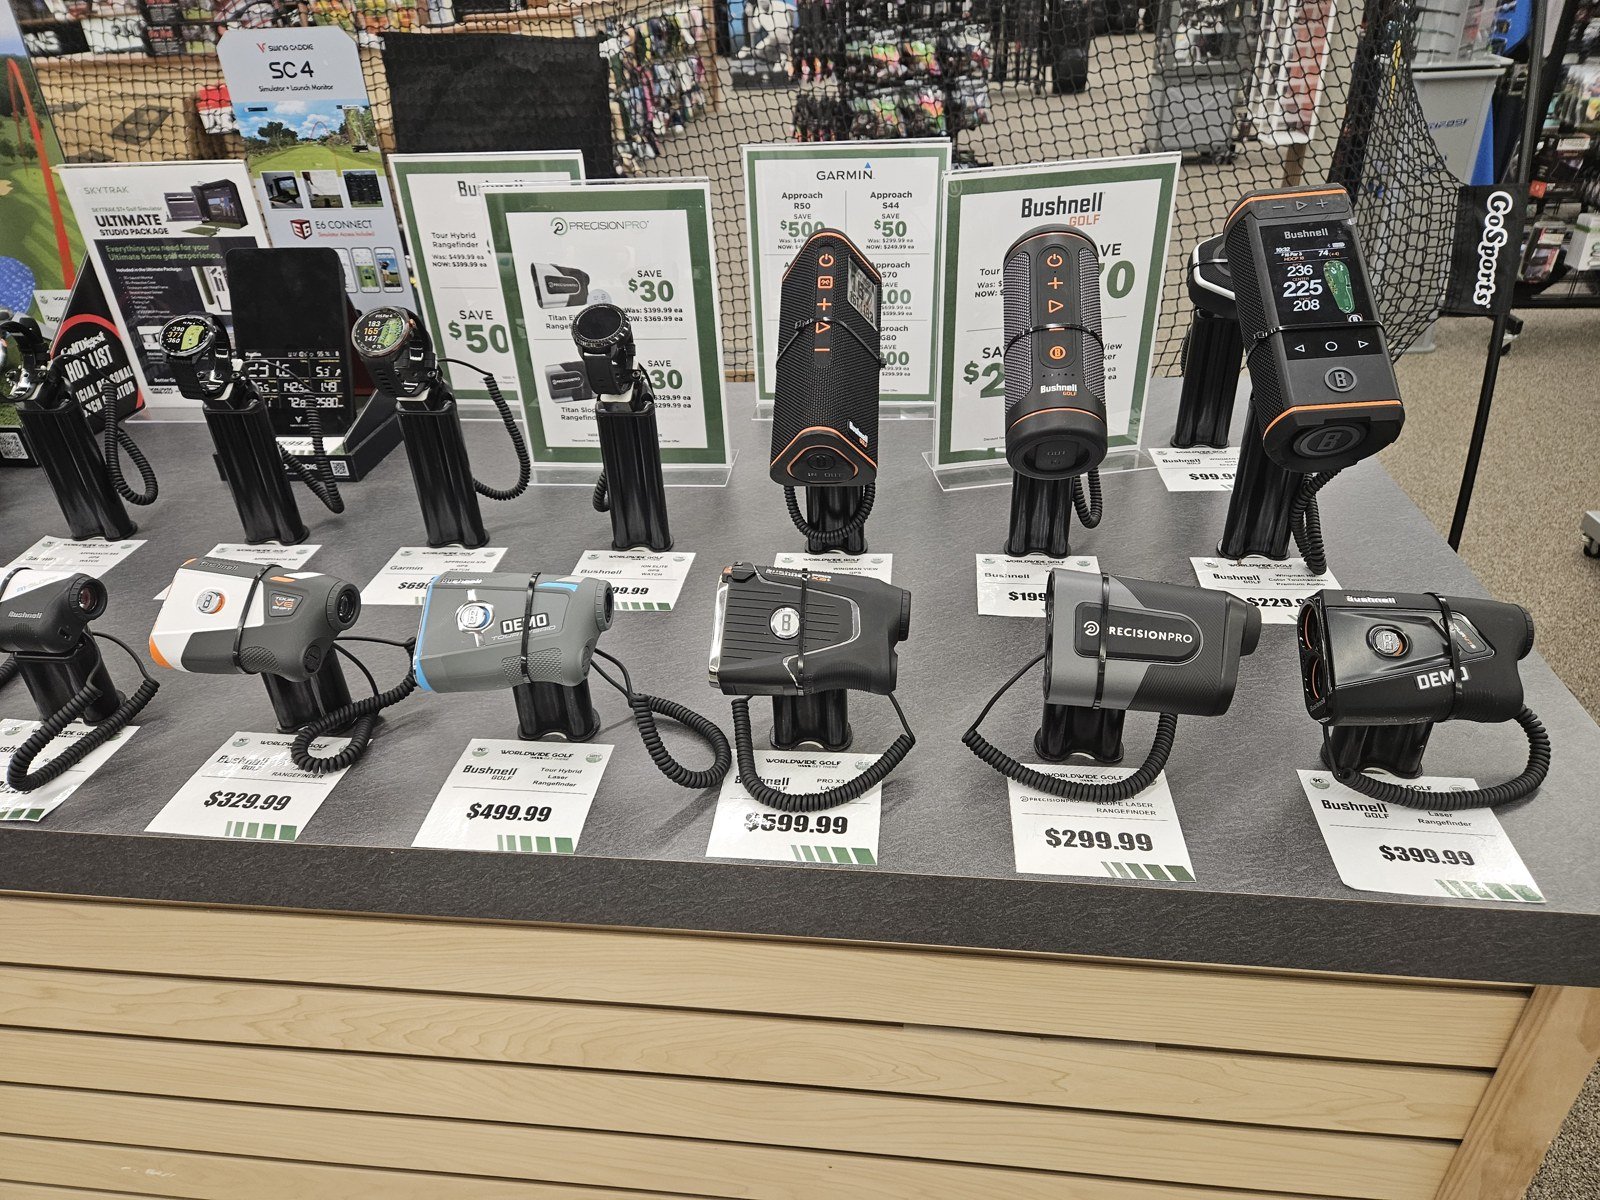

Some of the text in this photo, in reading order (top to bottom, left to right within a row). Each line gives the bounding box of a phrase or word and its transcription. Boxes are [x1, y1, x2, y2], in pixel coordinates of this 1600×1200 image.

[816, 170, 873, 180] GARMIN
[83, 186, 128, 195] SKYTRAK
[782, 191, 823, 200] Approach
[870, 191, 913, 200] Approach
[1021, 192, 1104, 218] Bushnell
[94, 214, 162, 228] ULTIMATE
[315, 220, 372, 230] E6 CONNECT
[569, 220, 648, 230] PRECISIONPRO
[1069, 214, 1100, 226] GOLF
[100, 228, 170, 236] STUDIO PACKAGE
[874, 219, 908, 238] $50
[450, 232, 476, 240] Hybrid
[1284, 228, 1328, 240] Bushnell
[105, 245, 150, 254] Everything
[432, 241, 478, 250] Rangefinder
[1472, 190, 1513, 306] GoSports
[108, 253, 141, 261] Ultimate
[165, 253, 178, 261] golf
[637, 270, 662, 278] SAVE
[980, 268, 1000, 276] Tour
[1287, 265, 1313, 277] 236
[628, 278, 674, 302] $30
[974, 289, 998, 298] NOW:
[1283, 279, 1323, 298] 225
[1293, 299, 1320, 312] 208
[459, 310, 494, 320] SAVE
[448, 320, 510, 354] $50
[65, 344, 114, 383] HOT LIST
[650, 369, 683, 390] 30
[1040, 384, 1078, 394] Bushnell
[1212, 573, 1260, 581] Bushnell
[274, 600, 294, 608] V6
[1346, 595, 1396, 604] Bushnell
[1107, 626, 1192, 644] RECISIONPRO
[500, 750, 550, 758] WORLDWIDE
[462, 764, 518, 776] Bushnell
[271, 772, 324, 780] RANGEFINDER
[204, 790, 292, 811] $329.99
[1320, 800, 1388, 812] Bushnell
[466, 802, 552, 822] $499.99
[1096, 808, 1156, 816] RANGEFINDER
[744, 812, 848, 834] $599.99
[1418, 818, 1472, 828] Rangefinder
[1044, 828, 1154, 852] $299.99
[1378, 844, 1475, 866] $399.99
